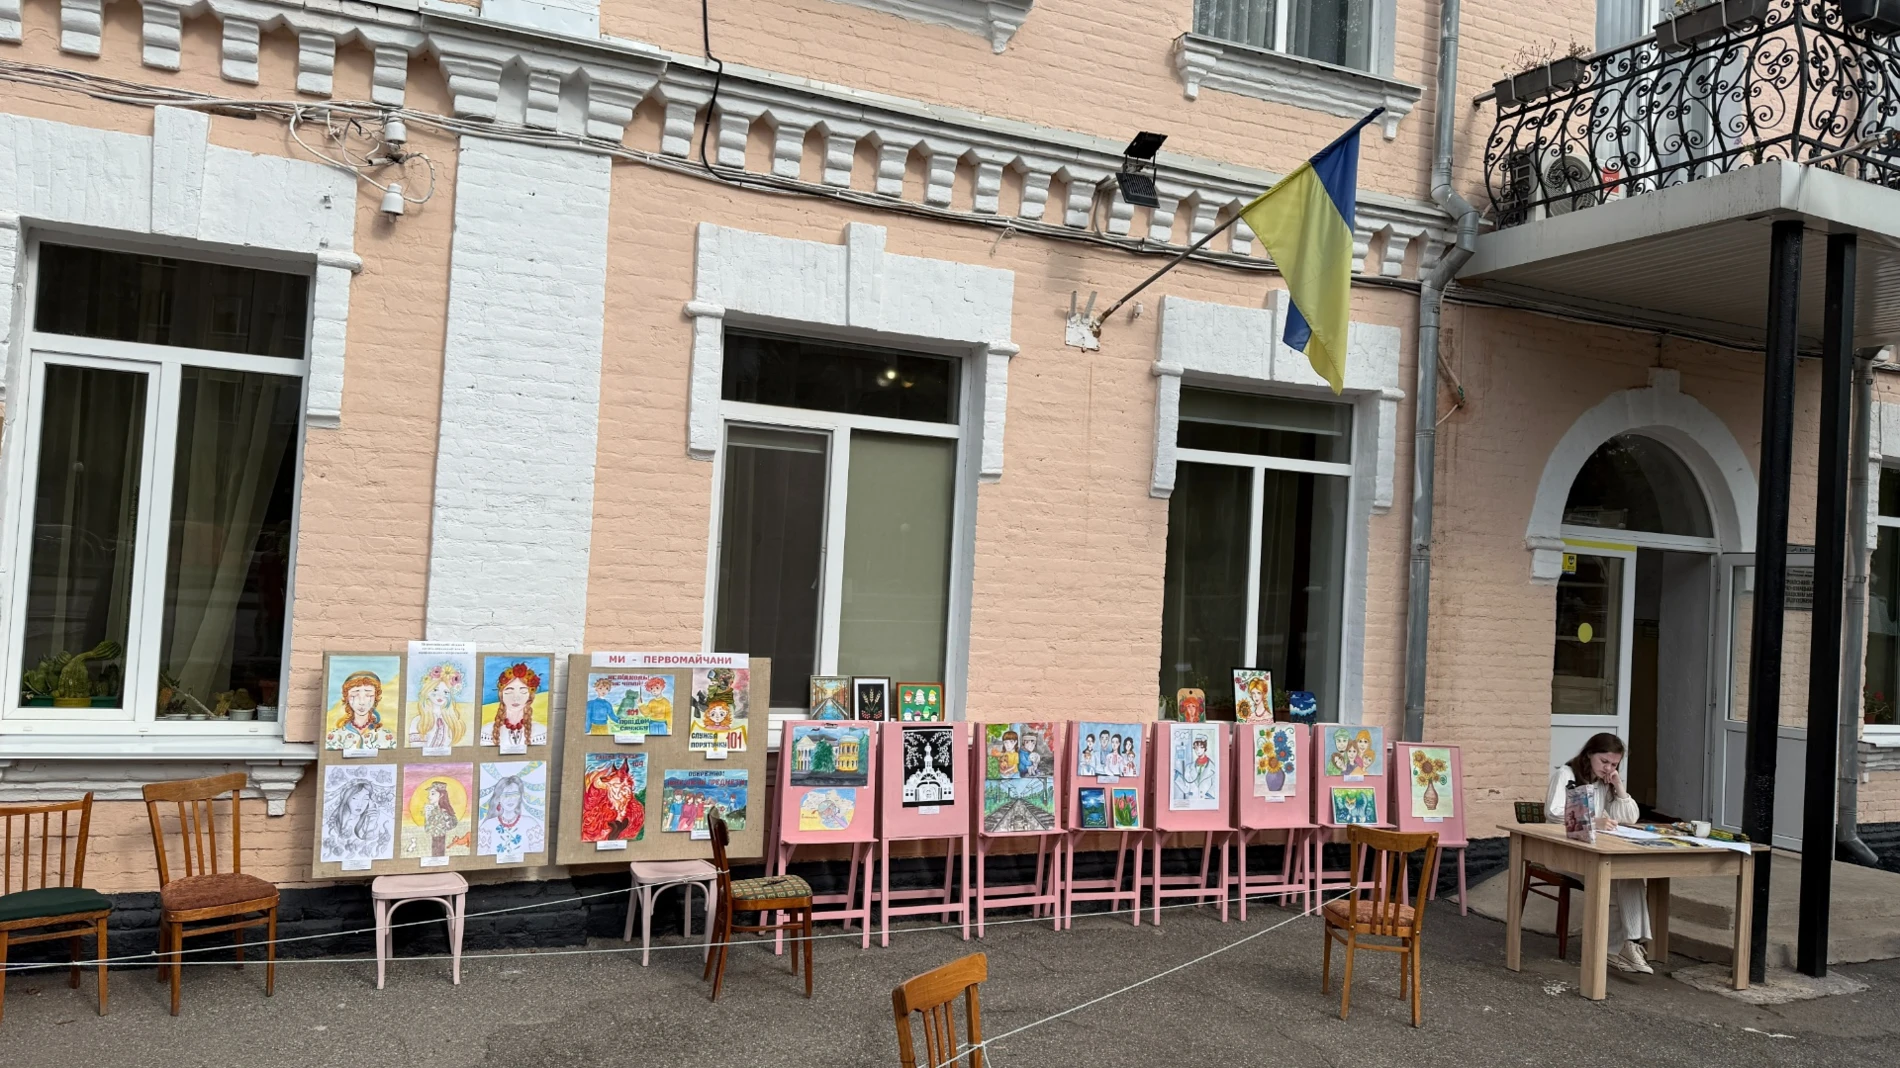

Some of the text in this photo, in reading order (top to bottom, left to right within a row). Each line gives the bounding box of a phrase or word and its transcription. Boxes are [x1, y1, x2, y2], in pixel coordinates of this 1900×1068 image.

[644, 654, 732, 664] ПЕРВОМАЙЧАНИ
[691, 732, 718, 740] СЛУЖБА
[726, 731, 742, 750] 101
[690, 741, 727, 749] ПОРЯТУНКУ
